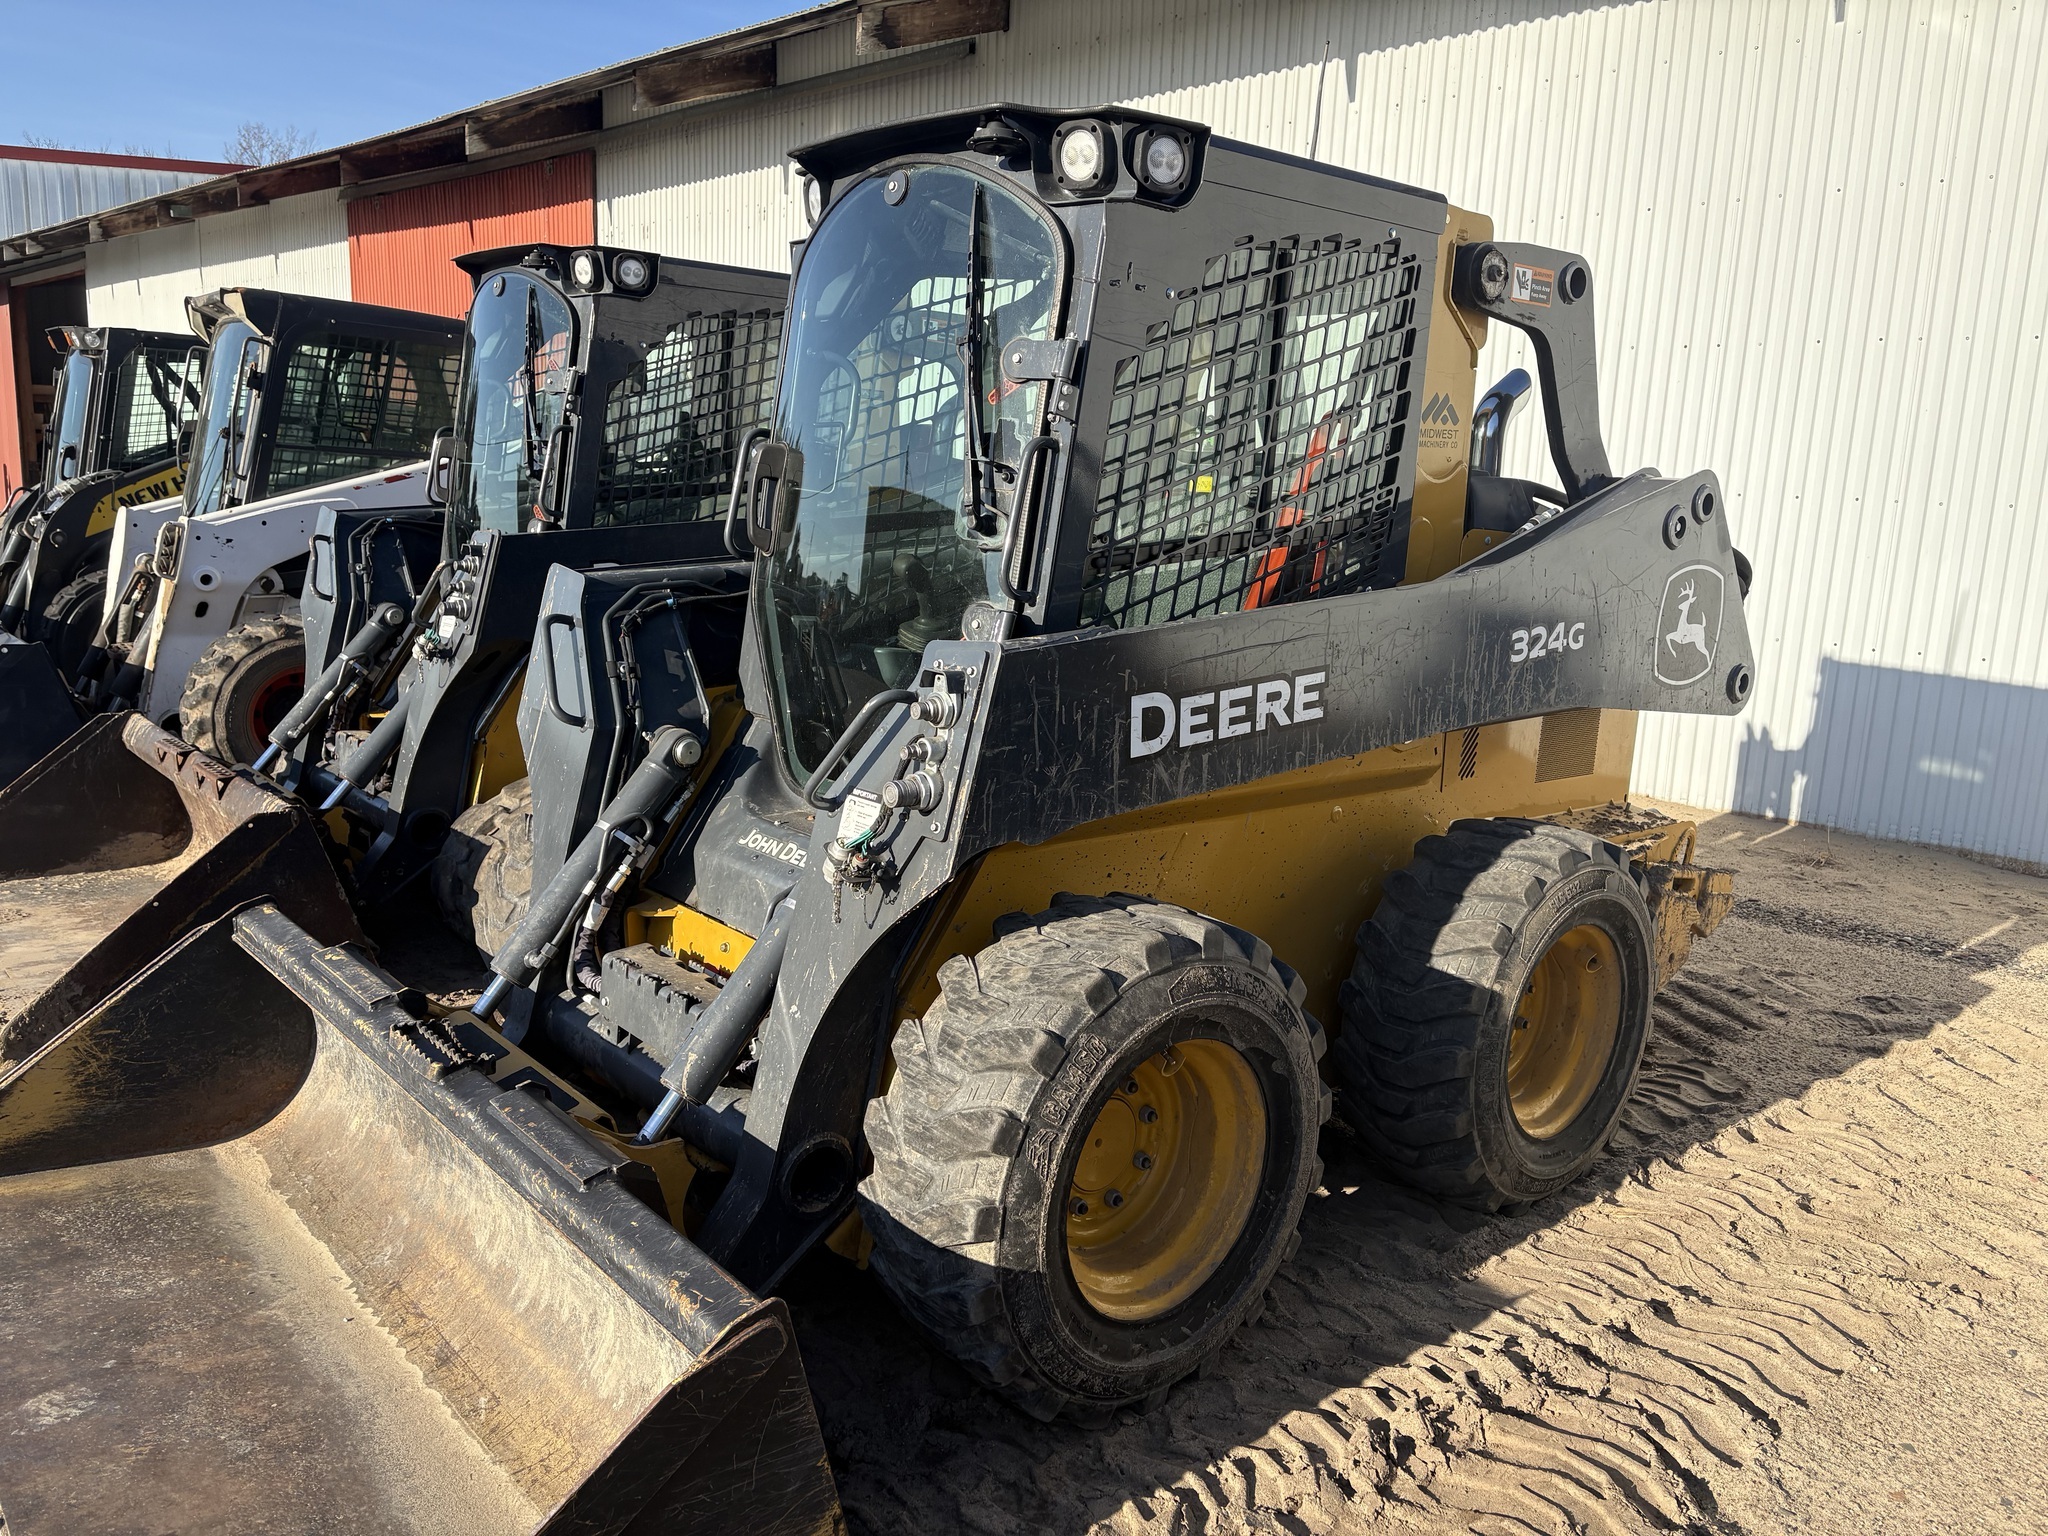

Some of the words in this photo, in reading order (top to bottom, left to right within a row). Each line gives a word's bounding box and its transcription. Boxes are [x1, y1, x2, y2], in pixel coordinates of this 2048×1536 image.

[1419, 440, 1450, 449] MACHINERY
[1451, 441, 1458, 449] CO
[1420, 428, 1460, 440] MIDWEST
[118, 481, 169, 507] NEW
[1510, 621, 1585, 663] 324G
[1130, 671, 1326, 759] DEERE
[738, 828, 784, 857] JOHN
[1040, 1033, 1107, 1127] CAMSO
